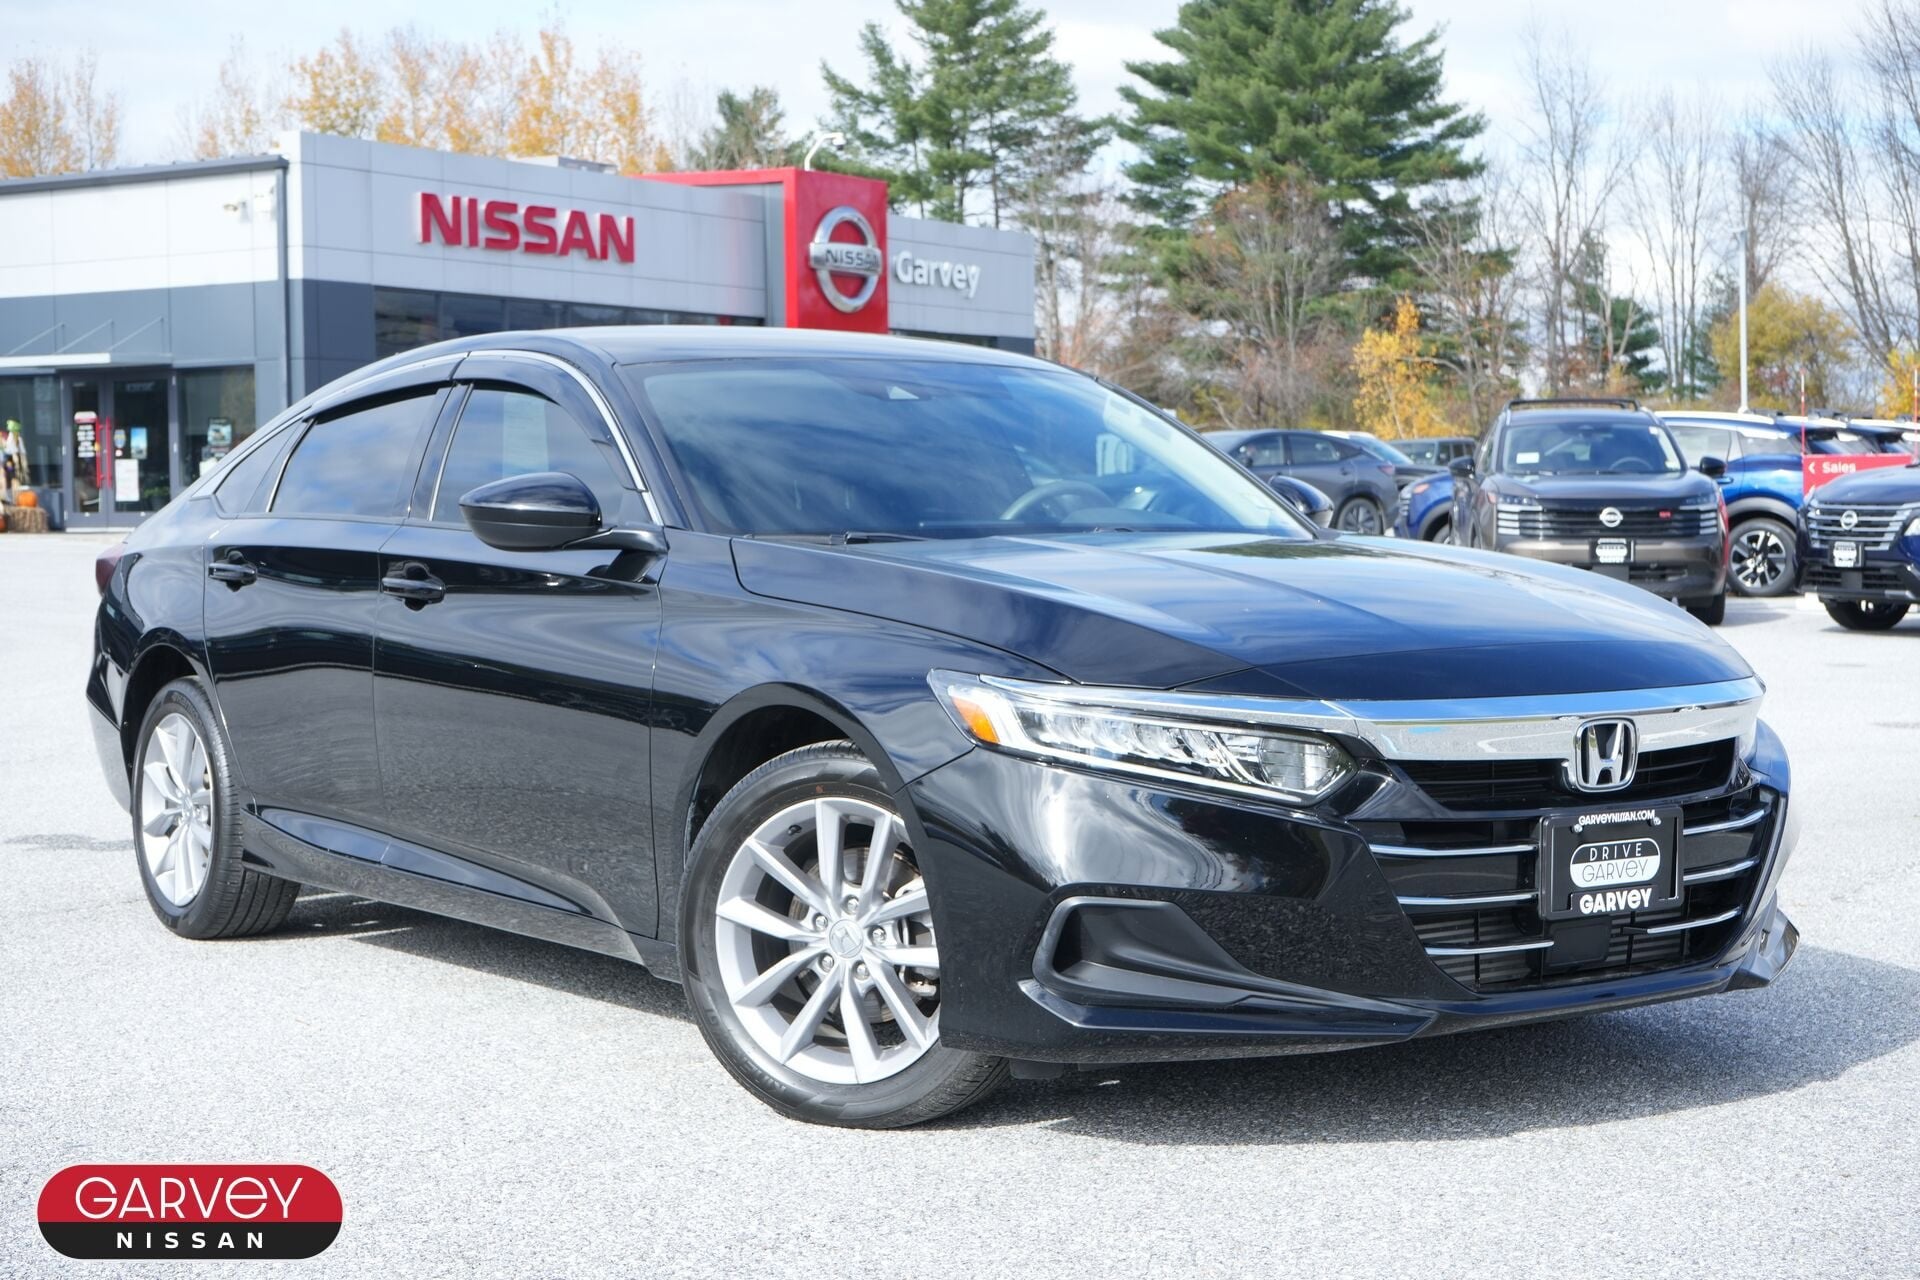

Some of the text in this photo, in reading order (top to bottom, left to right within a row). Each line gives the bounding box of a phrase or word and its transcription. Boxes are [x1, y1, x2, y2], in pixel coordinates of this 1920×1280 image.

[418, 192, 635, 263] NISSAN
[894, 251, 981, 299] Garvey
[1822, 461, 1856, 474] Sales
[1589, 842, 1643, 862] DRIVE
